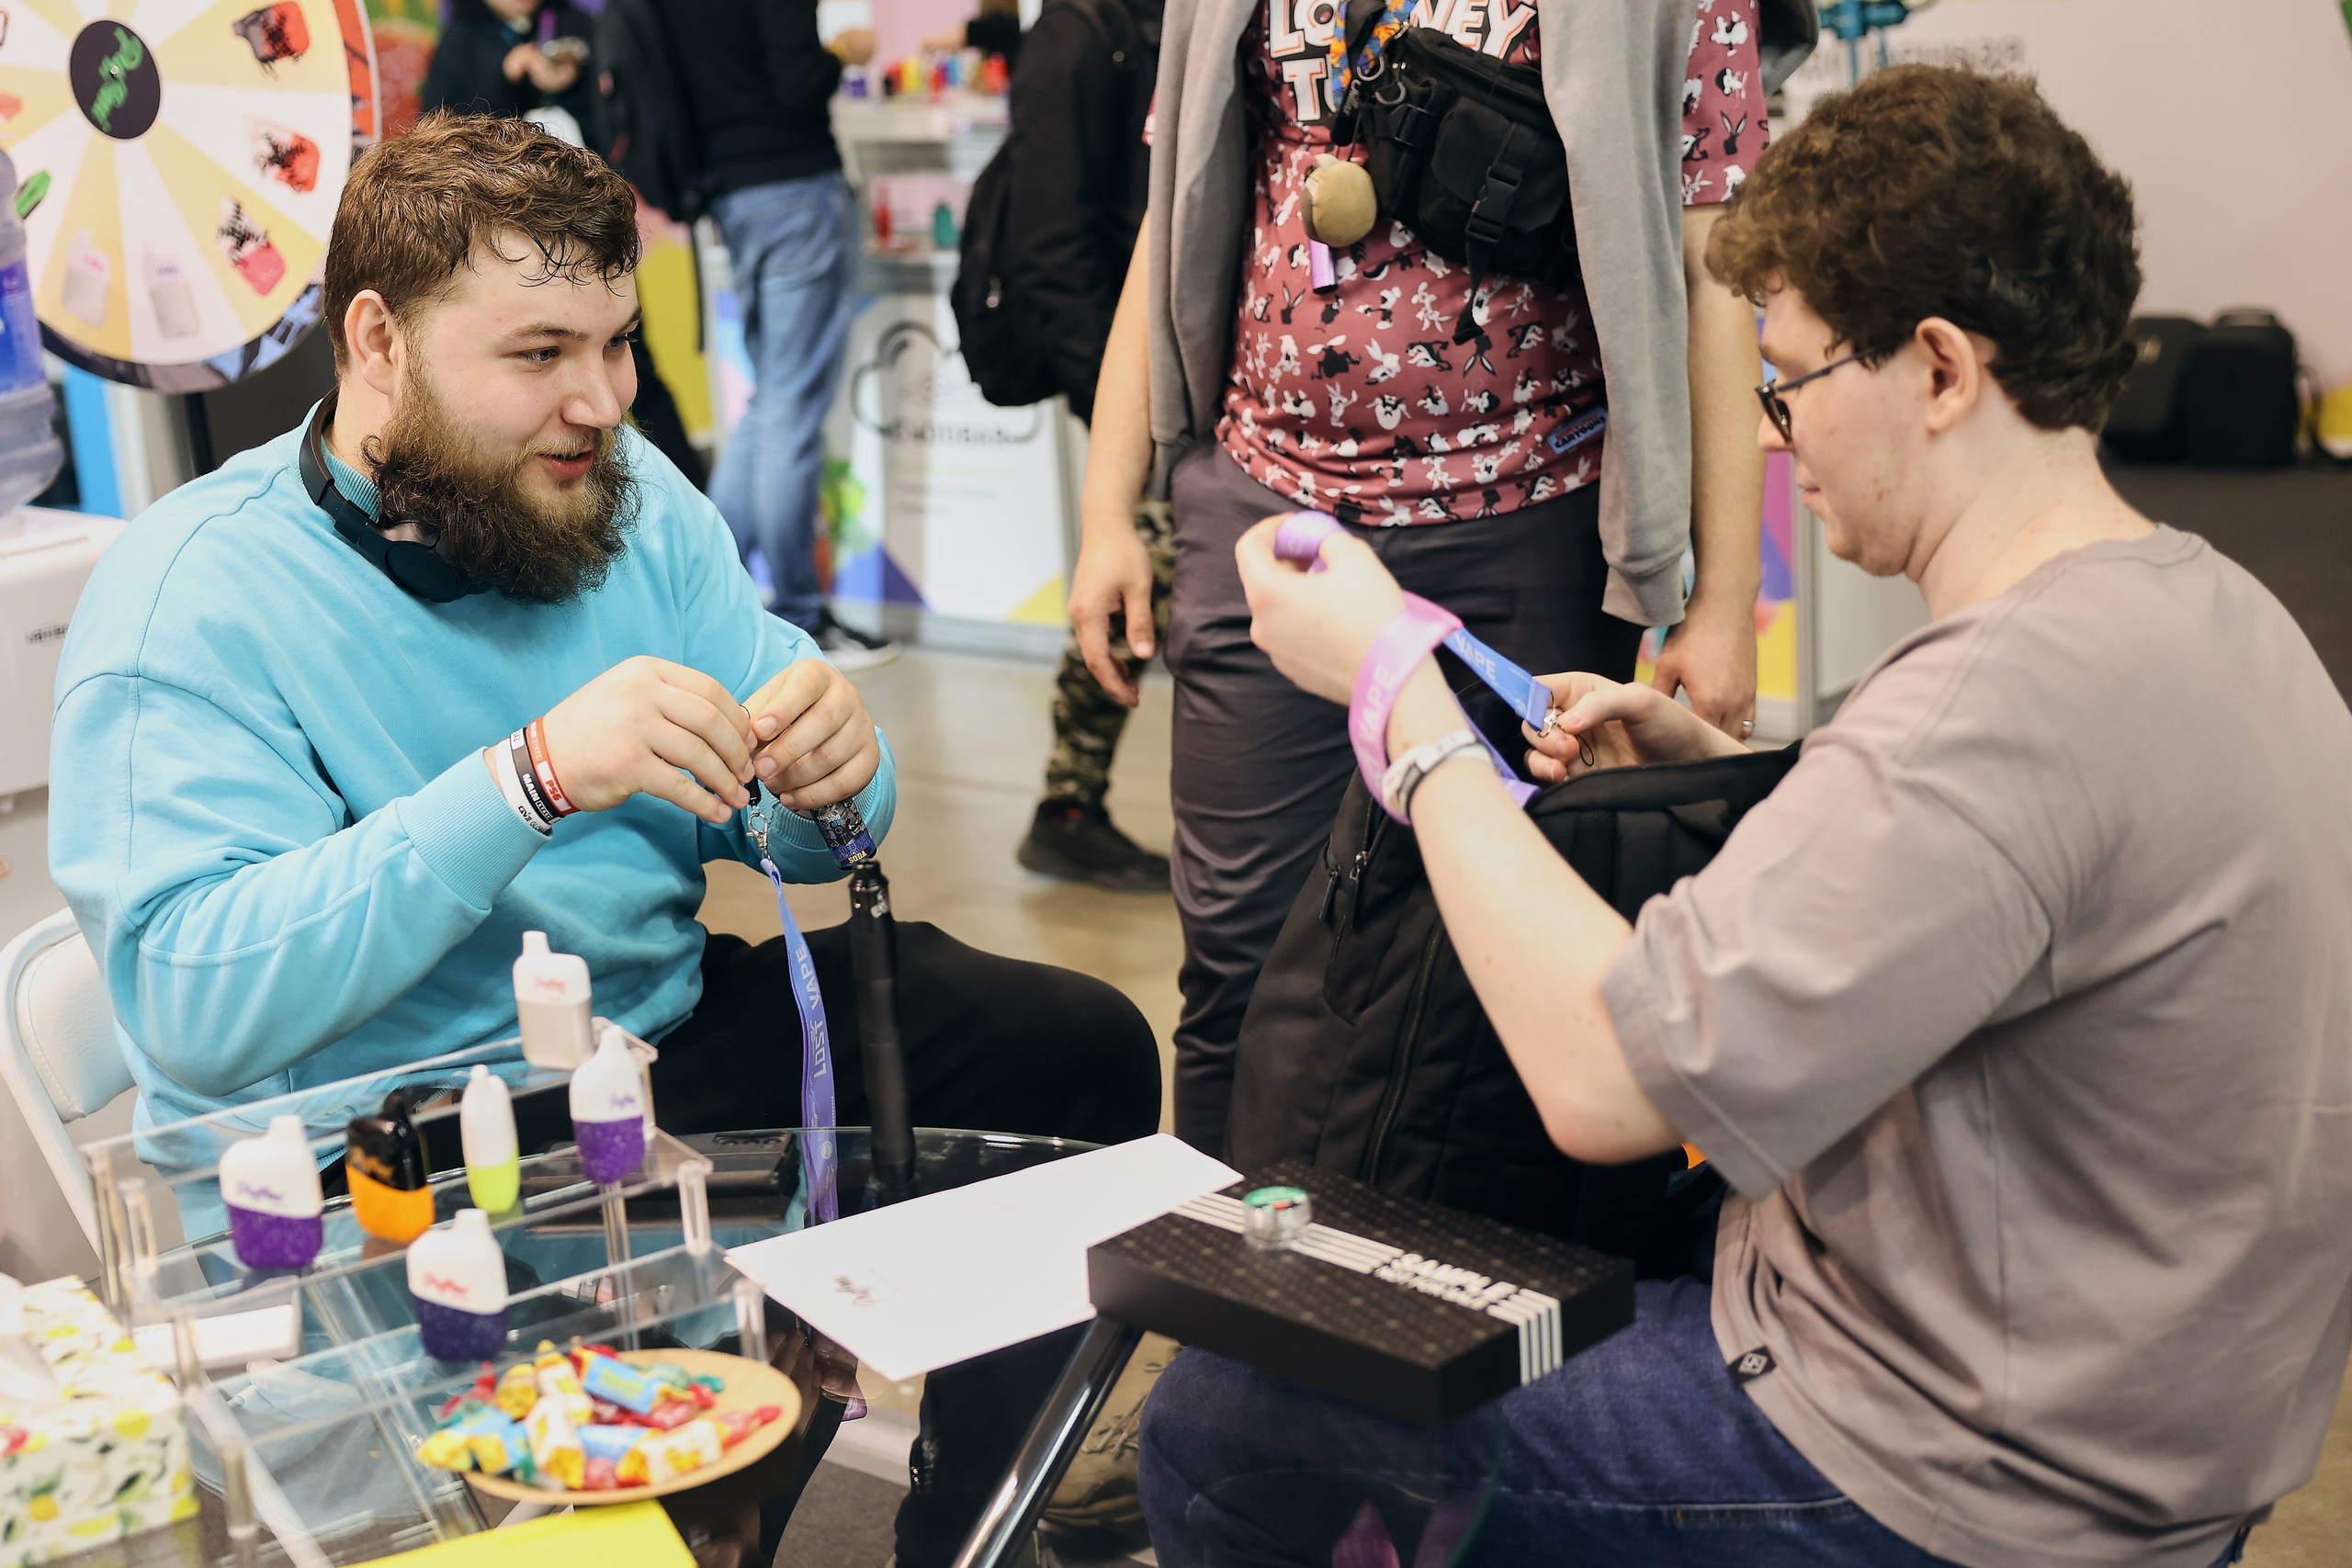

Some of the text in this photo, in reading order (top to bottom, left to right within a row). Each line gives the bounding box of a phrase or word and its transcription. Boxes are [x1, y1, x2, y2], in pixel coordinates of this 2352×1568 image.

[1269, 0, 1538, 59] LONEY
[522, 773, 539, 801] MAIN
[848, 851, 867, 863] SODA
[796, 947, 822, 1010] VAPE
